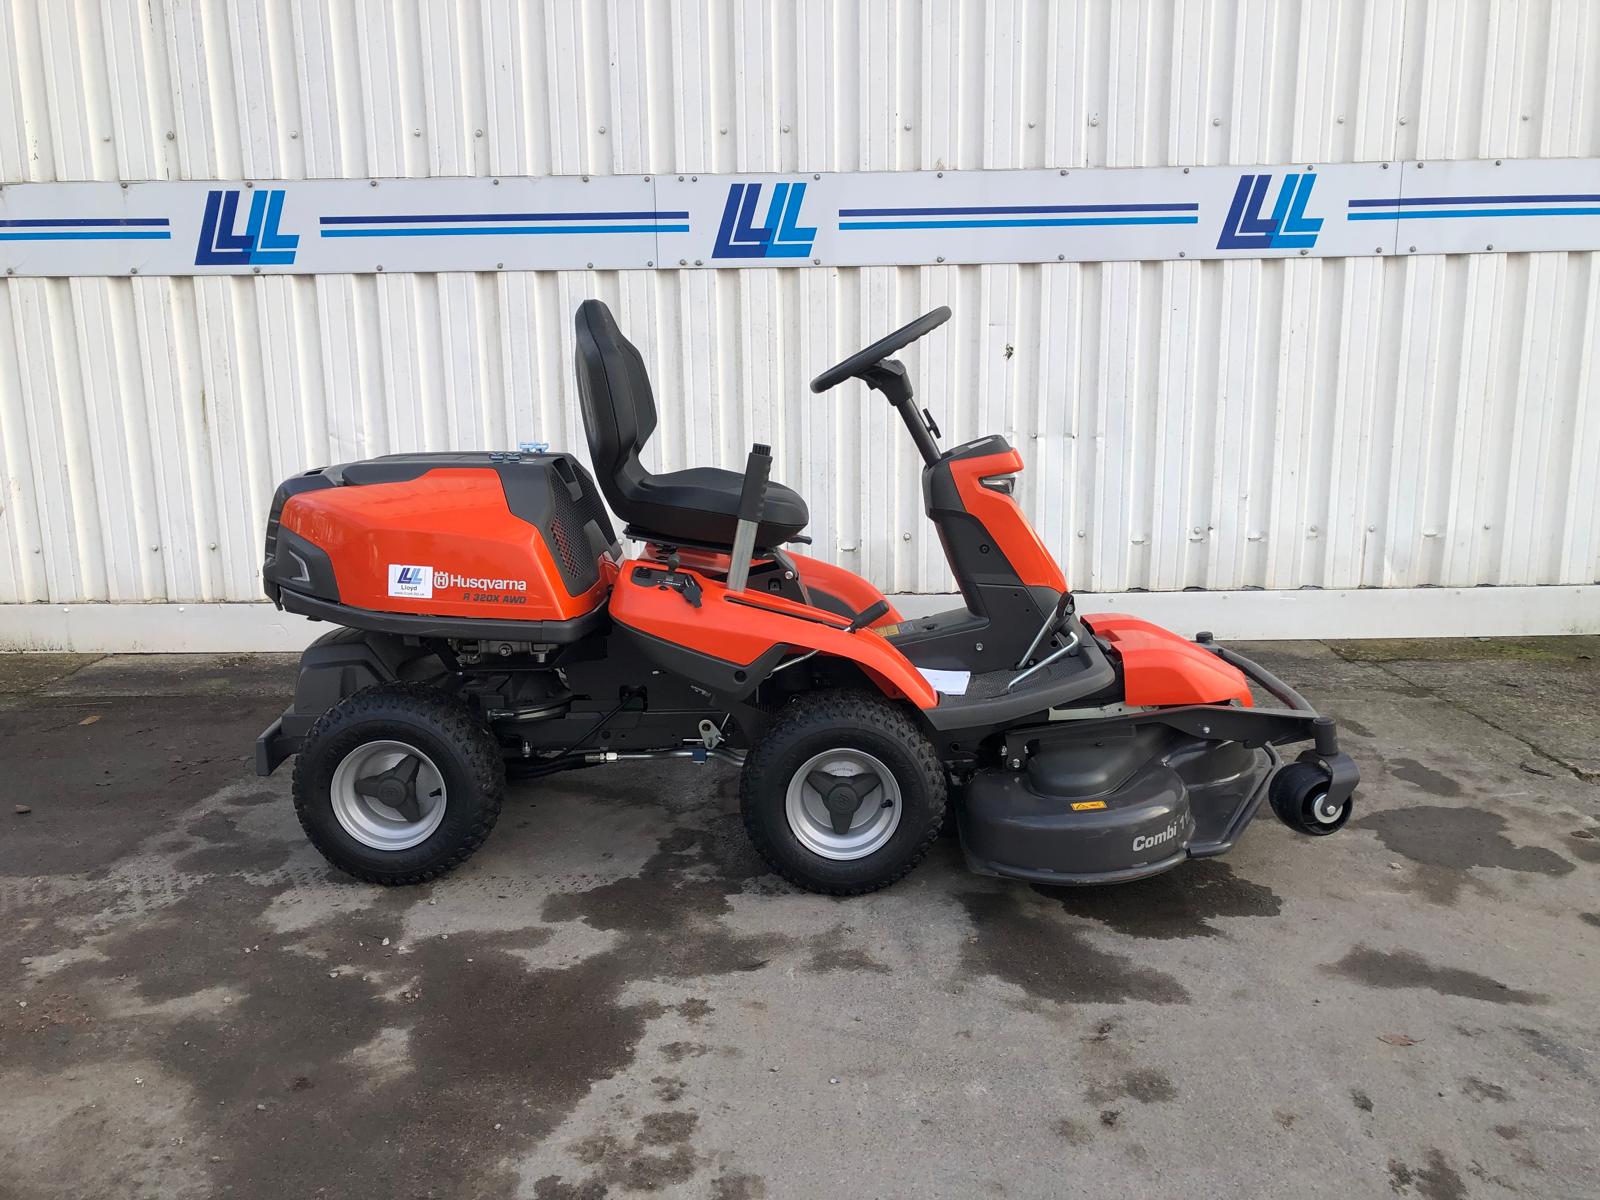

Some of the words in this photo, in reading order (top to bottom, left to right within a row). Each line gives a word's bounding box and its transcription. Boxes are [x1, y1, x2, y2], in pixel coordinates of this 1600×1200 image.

[450, 574, 527, 591] Husqvarna
[464, 592, 470, 601] R
[473, 593, 499, 602] 320X
[503, 595, 527, 604] AWD
[1132, 821, 1177, 852] Combi
